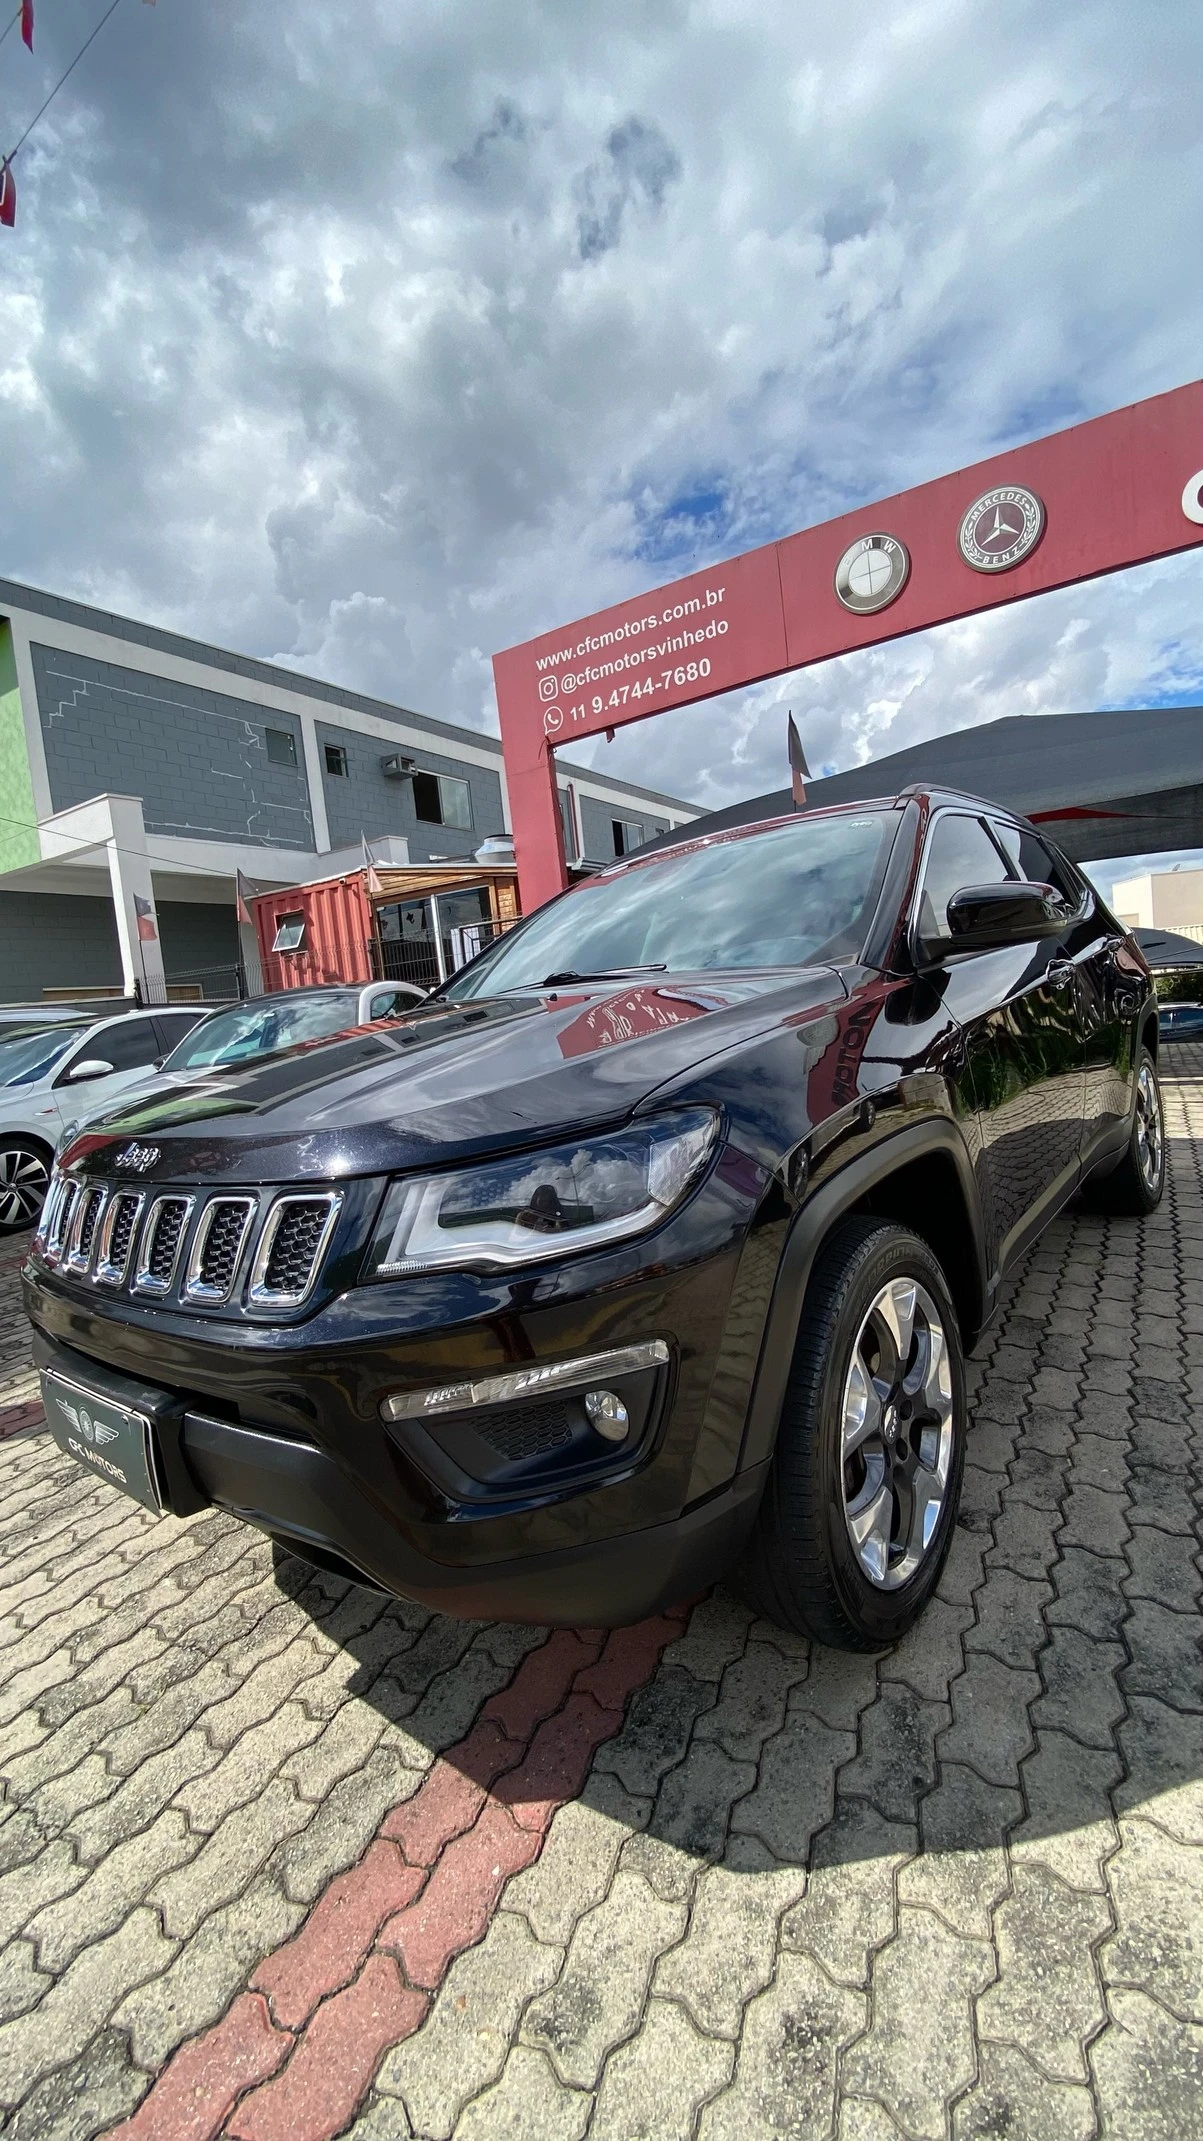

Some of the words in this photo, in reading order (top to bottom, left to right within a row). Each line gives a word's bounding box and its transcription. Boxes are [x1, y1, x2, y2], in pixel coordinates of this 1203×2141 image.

[971, 492, 1027, 522] MERCEDES
[982, 547, 1021, 565] BENZ
[535, 586, 726, 671] www.cfcmotors.com.br
[561, 618, 729, 694] @cfcmotorsvinhedo
[570, 703, 586, 721] 11
[592, 658, 712, 714] 9.4744-7680
[114, 1142, 161, 1173] Jeep
